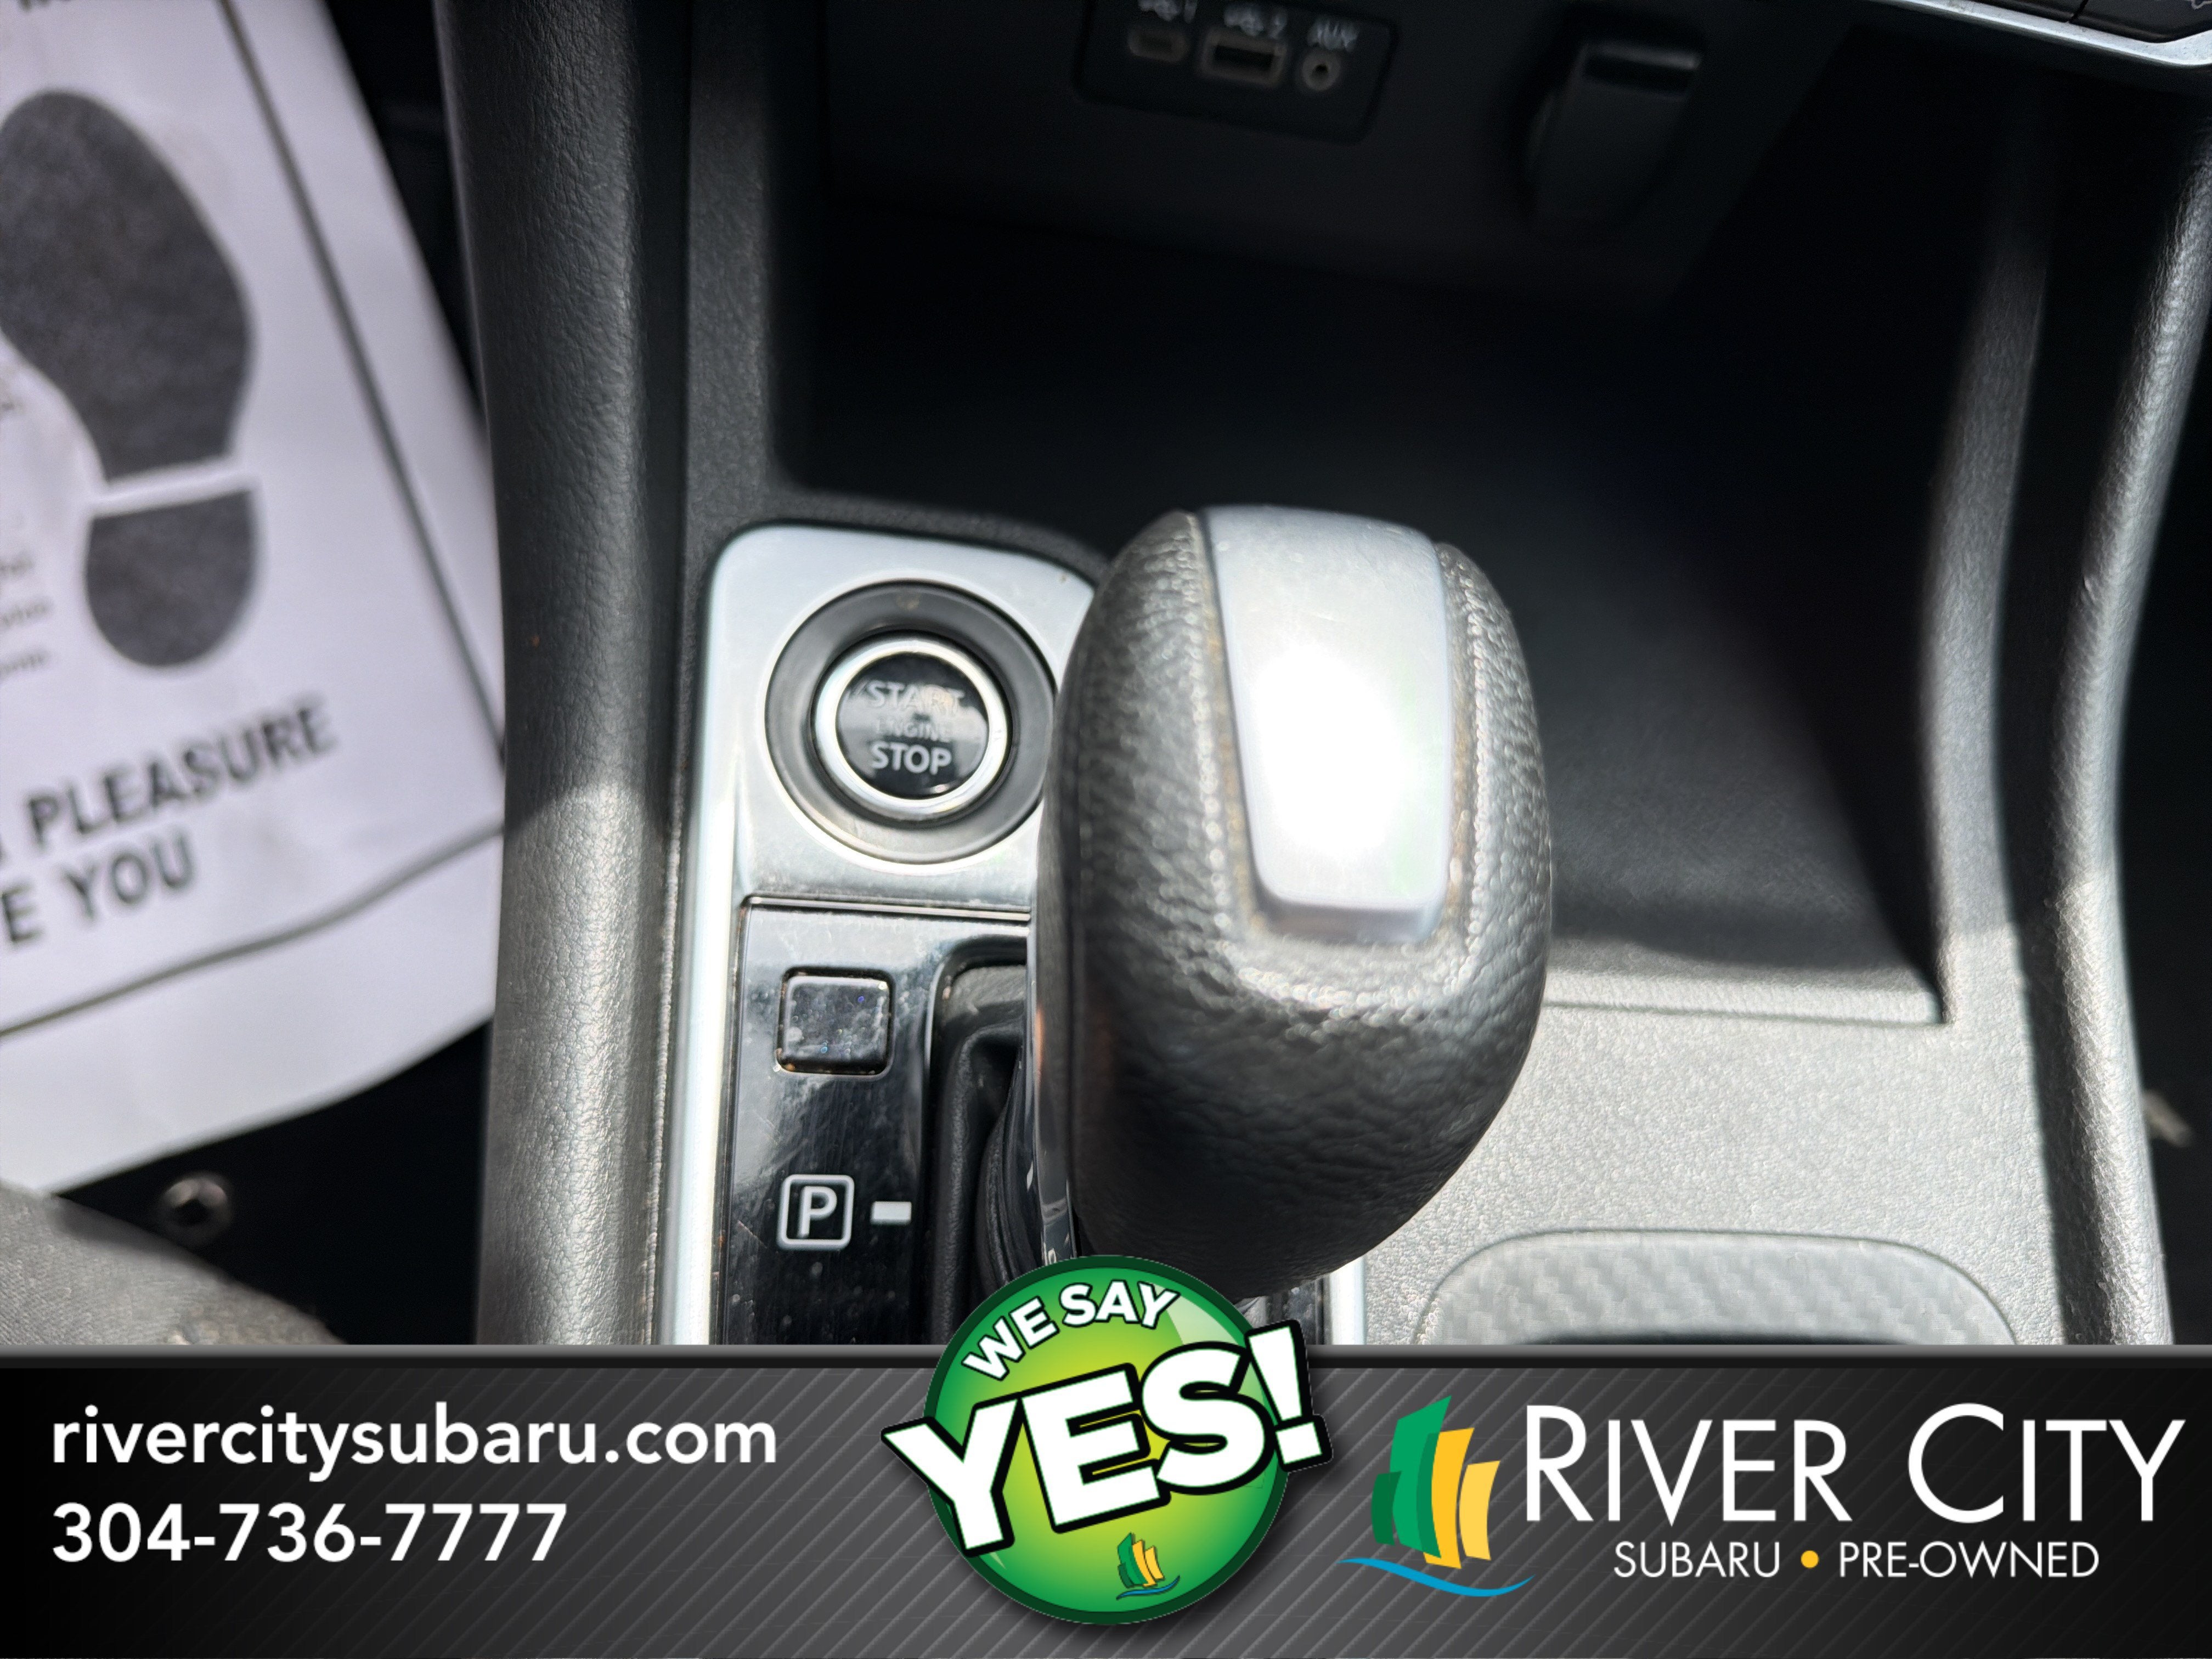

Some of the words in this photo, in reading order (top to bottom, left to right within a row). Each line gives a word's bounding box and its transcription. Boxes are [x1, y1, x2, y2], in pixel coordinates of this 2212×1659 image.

[866, 679, 964, 716] START
[27, 696, 335, 848] PLEASURE
[870, 741, 952, 775] STOP
[63, 831, 195, 922] YOU
[798, 1187, 837, 1237] P
